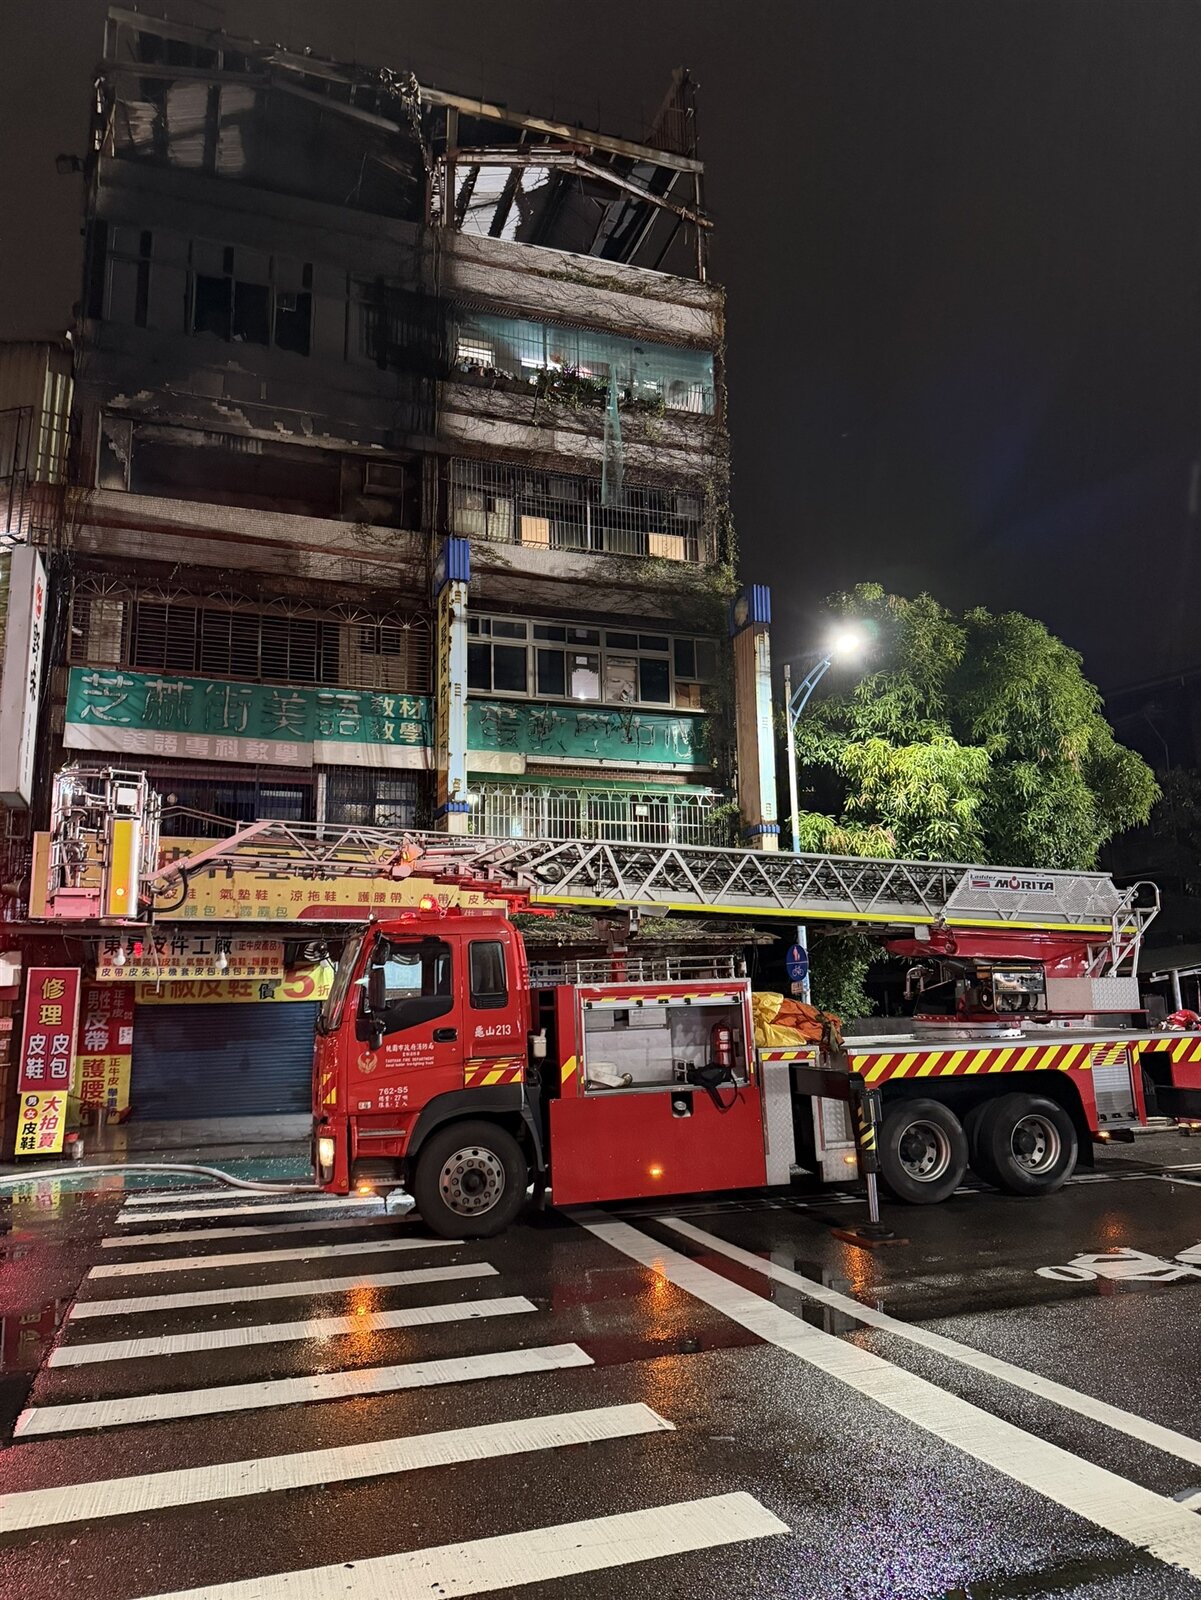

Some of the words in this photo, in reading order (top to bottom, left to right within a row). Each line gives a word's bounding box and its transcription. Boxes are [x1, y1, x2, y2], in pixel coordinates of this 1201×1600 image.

[123, 732, 299, 762] 美語專科教學
[995, 876, 1054, 891] MORITA
[38, 976, 66, 1026] 修理
[283, 967, 316, 999] 5
[317, 984, 331, 997] 折
[25, 1033, 47, 1079] 皮鞋
[50, 1033, 70, 1079] 皮包
[37, 1095, 62, 1149] 大拍賣
